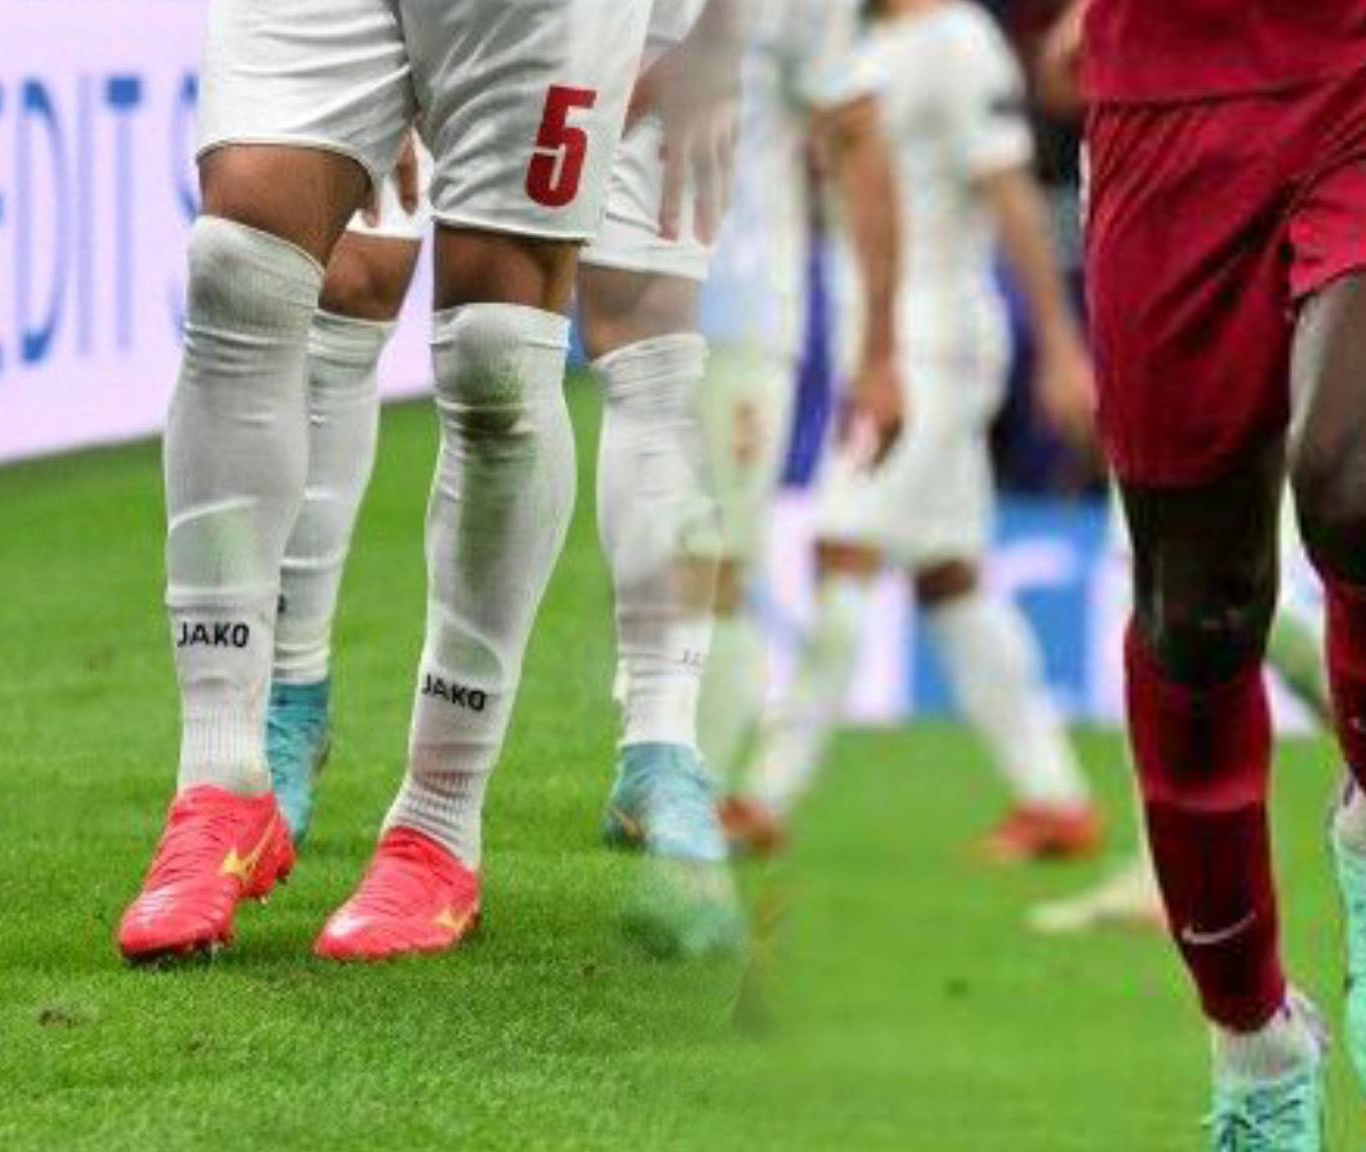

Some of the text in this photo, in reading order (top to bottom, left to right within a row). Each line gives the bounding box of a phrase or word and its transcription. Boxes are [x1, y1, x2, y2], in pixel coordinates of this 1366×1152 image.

[524, 83, 597, 207] 5
[177, 621, 250, 649] JAKO
[421, 673, 485, 712] JAKO
